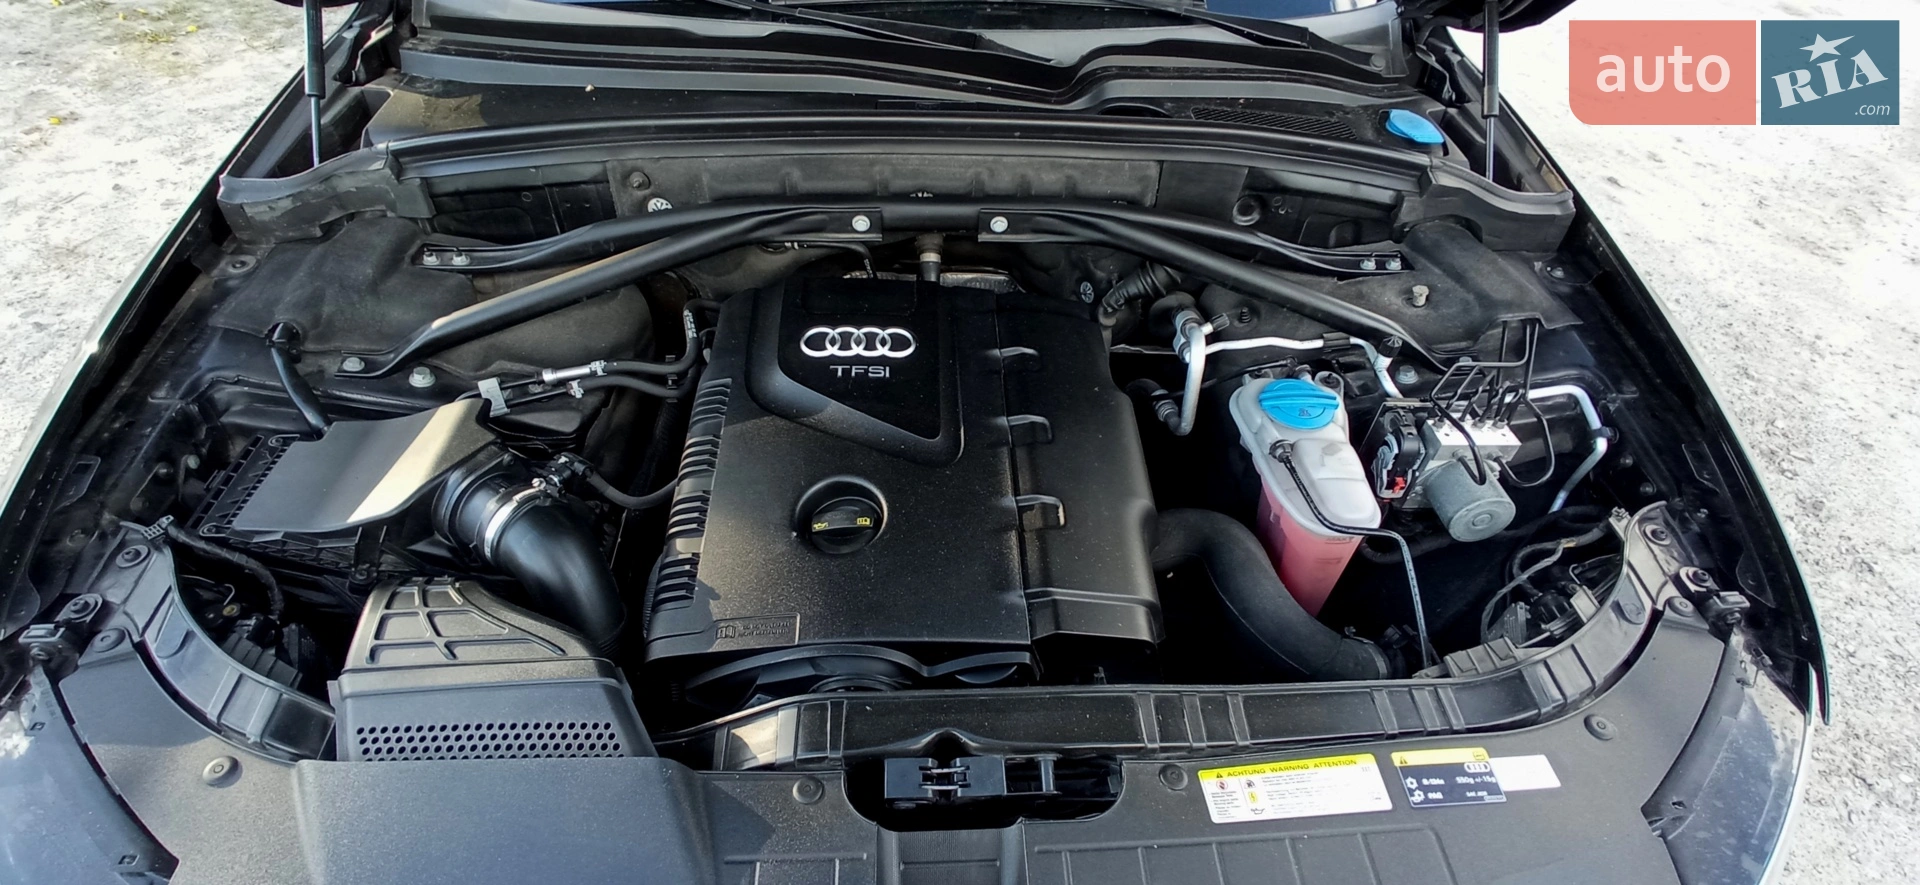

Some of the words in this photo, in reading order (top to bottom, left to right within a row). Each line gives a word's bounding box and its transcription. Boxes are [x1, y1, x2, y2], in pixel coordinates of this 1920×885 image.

[829, 365, 890, 378] TFSI
[1227, 768, 1266, 777] ACHTUNG
[1269, 763, 1309, 773] WARNING
[1313, 759, 1357, 769] ATTENTION
